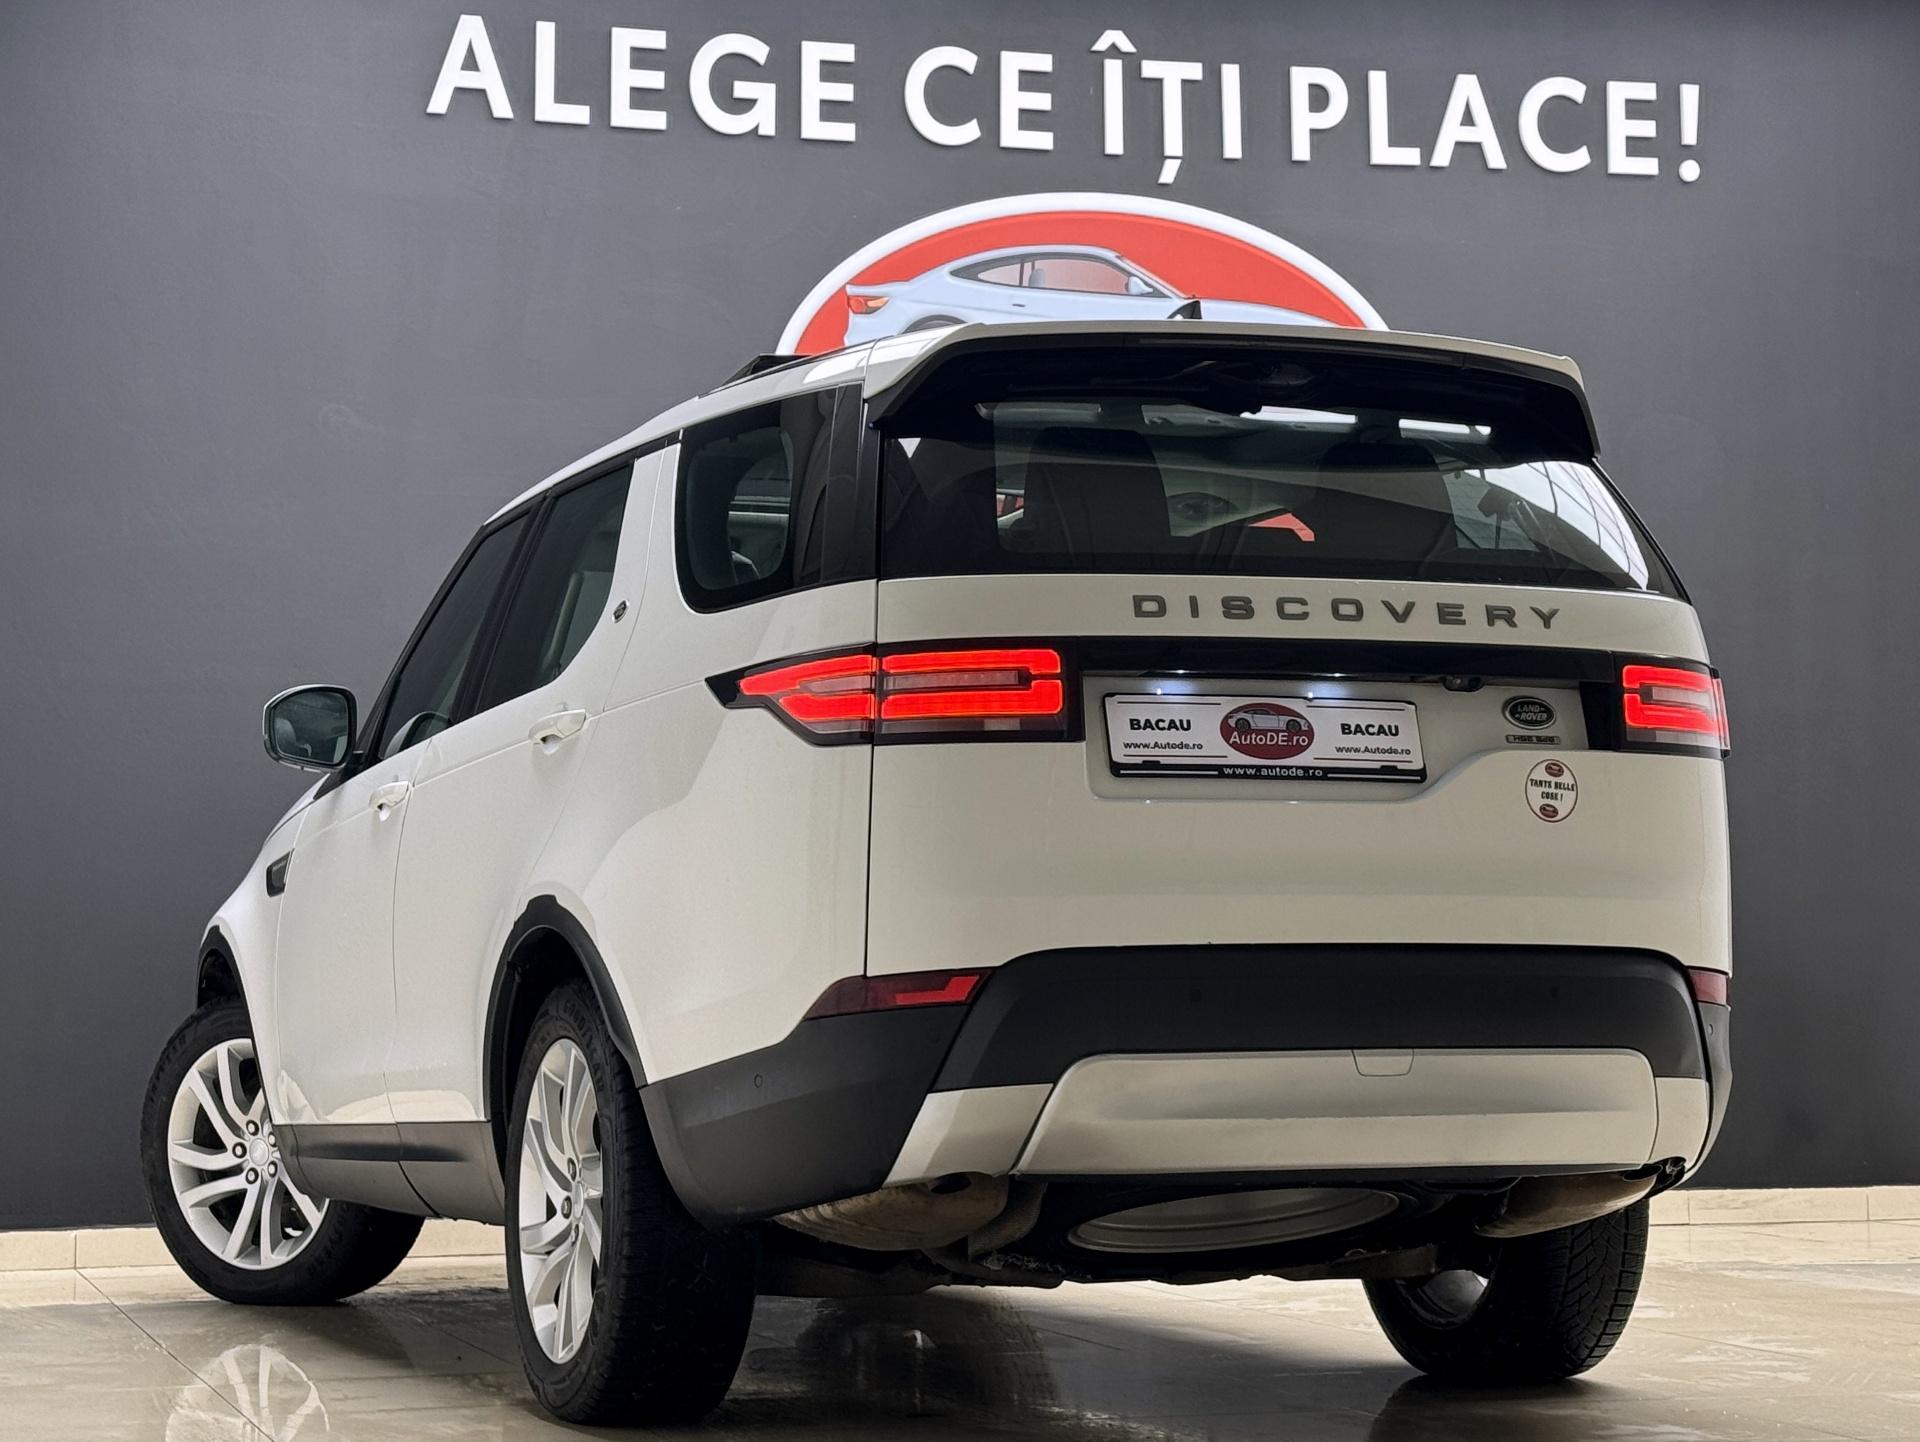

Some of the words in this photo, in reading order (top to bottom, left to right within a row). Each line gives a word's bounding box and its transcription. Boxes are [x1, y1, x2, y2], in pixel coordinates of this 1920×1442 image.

[426, 14, 856, 142] ALEGE
[904, 45, 1054, 151] CE
[1090, 29, 1243, 185] ÎȚI
[1289, 66, 1701, 183] PLACE!
[1132, 594, 1560, 630] DISCOVERY
[1128, 718, 1192, 732] BACAU
[1340, 722, 1400, 737] BACAU
[1122, 741, 1204, 750] www.Autode.ro
[1228, 731, 1309, 746] AutoDE.ro
[1334, 745, 1412, 755] www.Autode.ro
[1222, 767, 1324, 777] www.autode.ro
